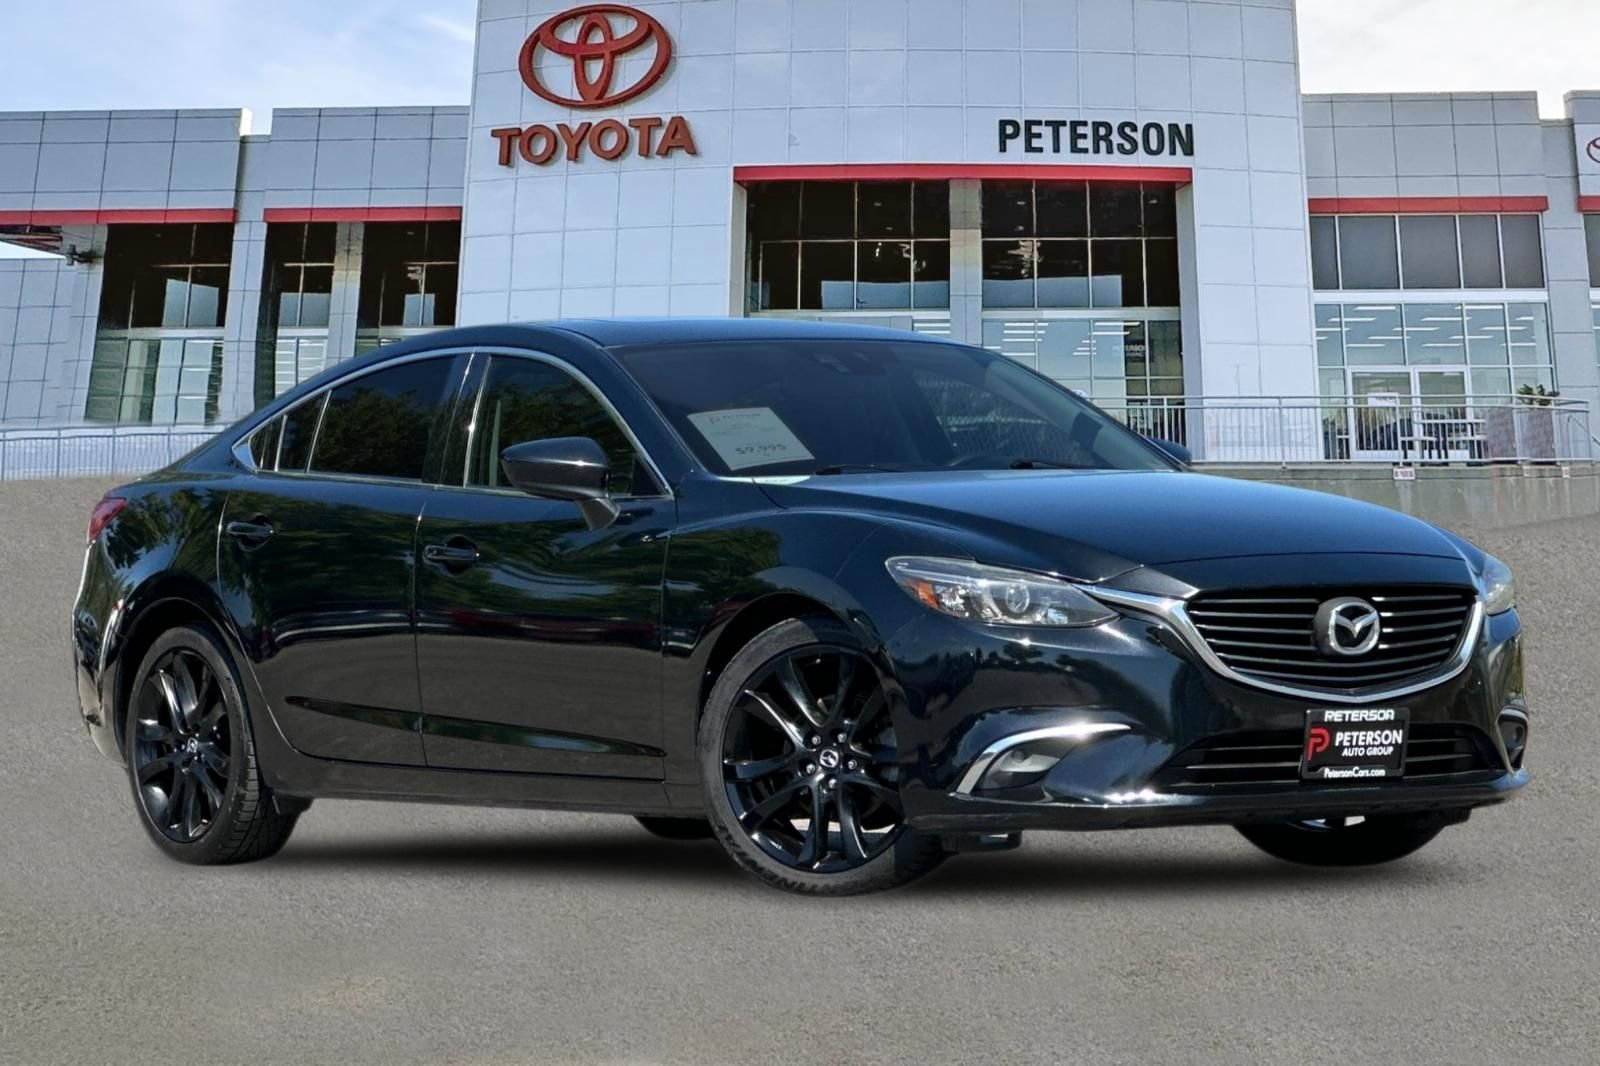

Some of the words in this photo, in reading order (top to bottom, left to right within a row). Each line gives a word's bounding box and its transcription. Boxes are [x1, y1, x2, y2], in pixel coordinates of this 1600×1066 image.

[490, 116, 697, 166] TOYOTA
[998, 119, 1195, 157] PETERSON
[1334, 729, 1403, 747] PETERSON
[1341, 747, 1365, 757] AUTO
[1366, 746, 1394, 756] GROUP
[1323, 766, 1386, 779] PetersonCars.com
